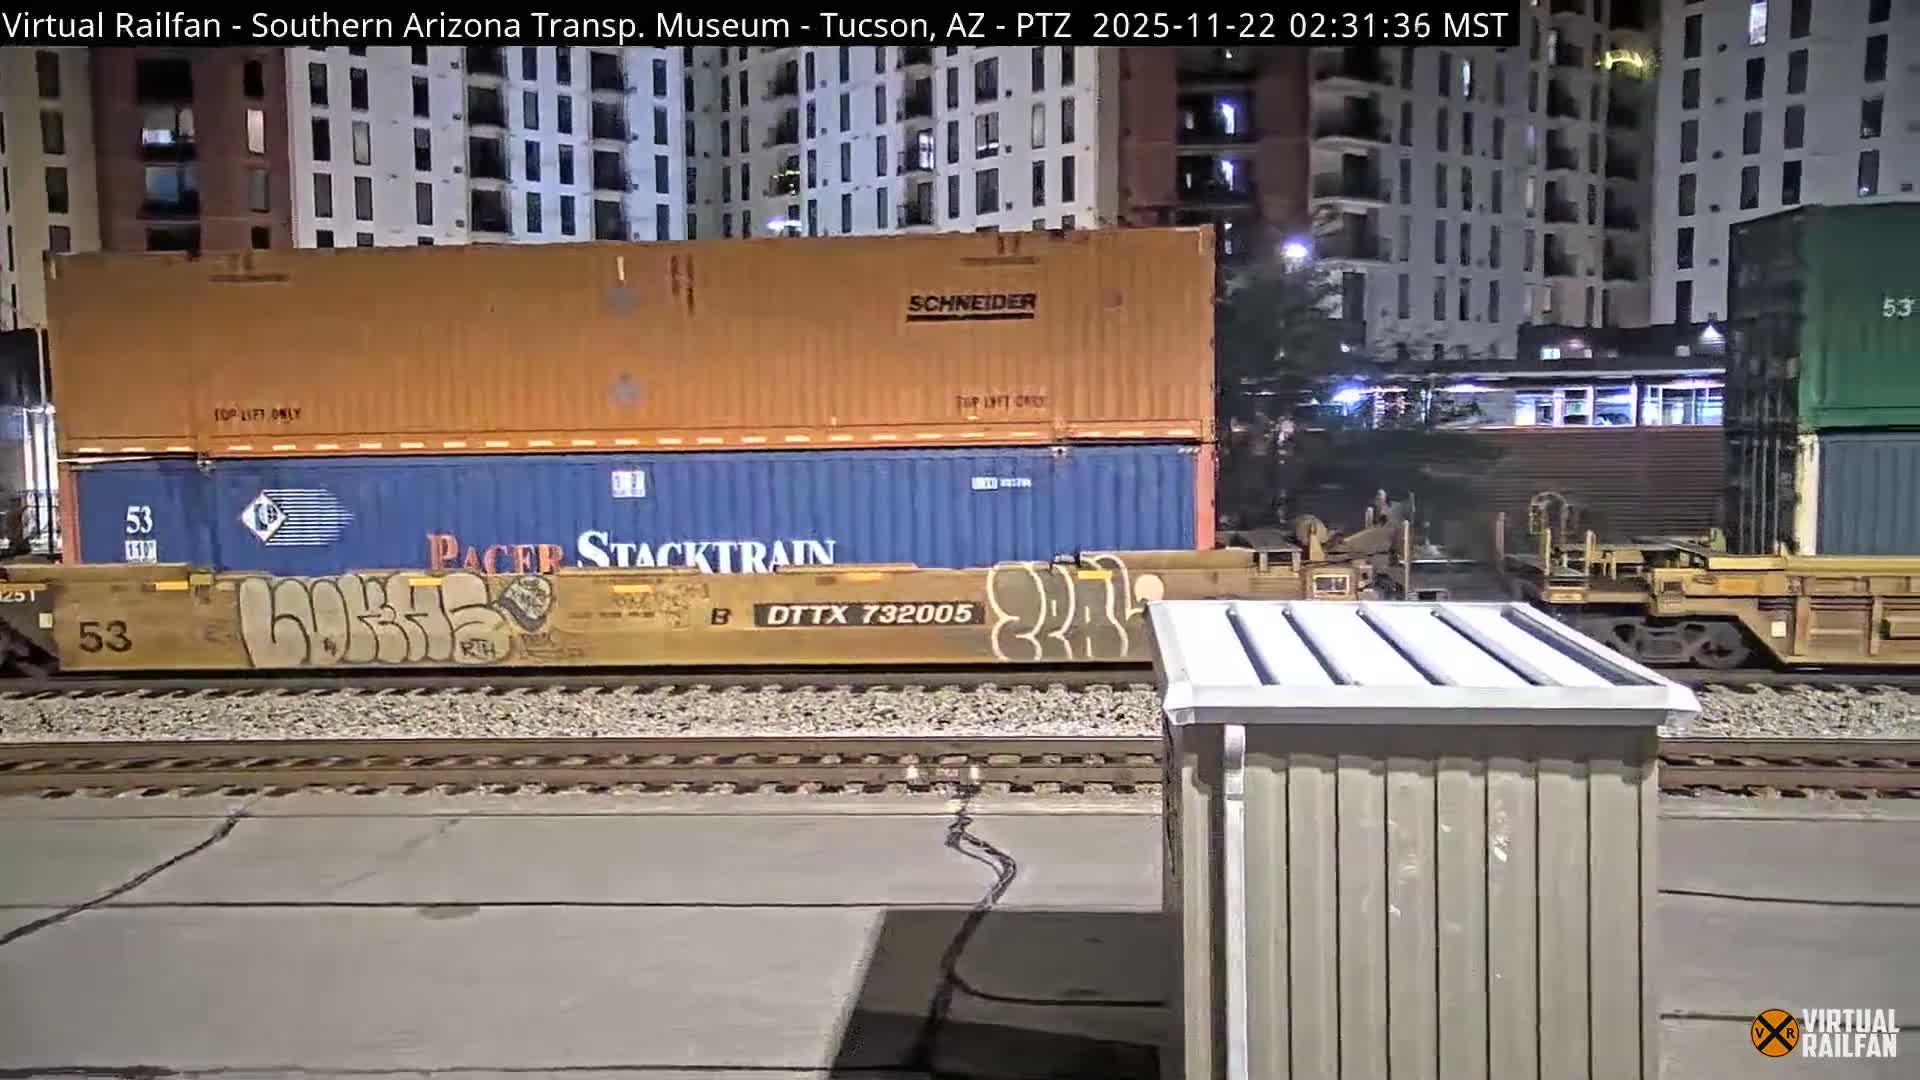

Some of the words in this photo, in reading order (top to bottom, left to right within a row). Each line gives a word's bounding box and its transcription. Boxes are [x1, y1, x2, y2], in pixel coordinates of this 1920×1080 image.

[908, 292, 1037, 313] SCHNEIDER
[126, 505, 153, 534] 53
[427, 531, 564, 575] PACER
[576, 529, 836, 575] STACKTRAIN
[711, 607, 730, 625] B
[767, 604, 849, 625] DTTX
[862, 603, 974, 624] 732005
[79, 620, 132, 652] 53
